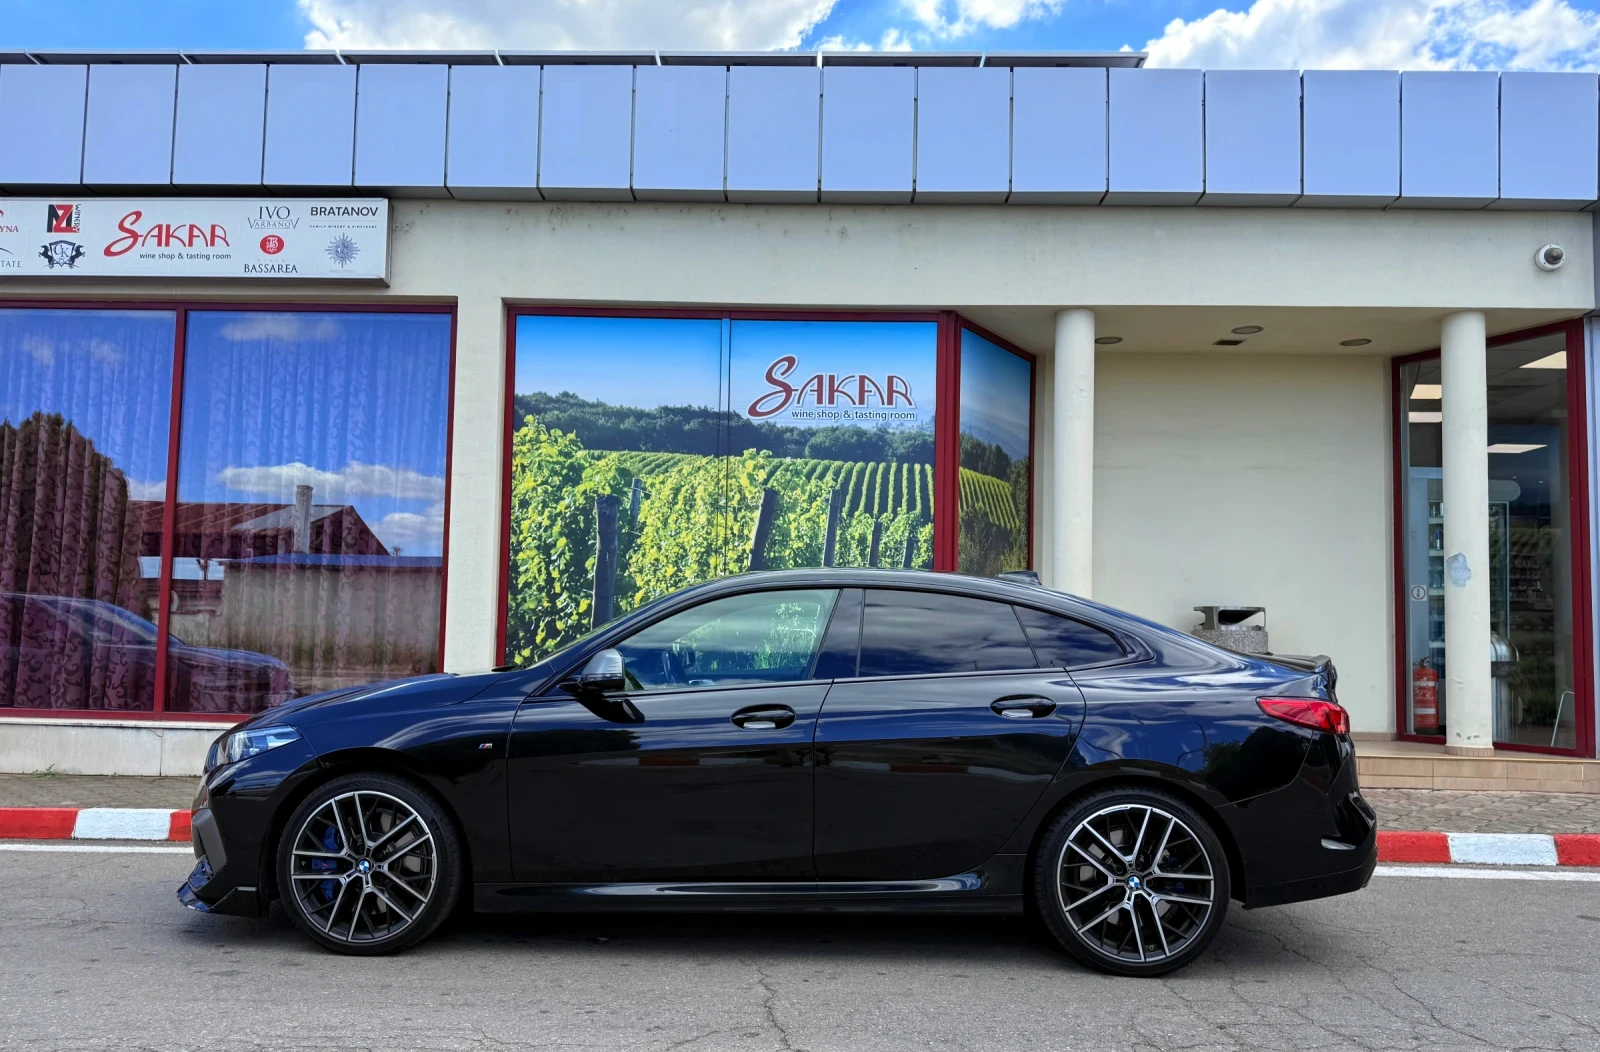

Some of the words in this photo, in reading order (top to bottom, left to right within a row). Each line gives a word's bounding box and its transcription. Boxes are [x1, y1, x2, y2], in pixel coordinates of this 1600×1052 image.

[73, 203, 82, 232] WINERY
[259, 206, 291, 220] IVO
[310, 206, 379, 217] BRATANOV
[247, 216, 300, 230] VARBANOV
[103, 210, 231, 257] SAKAR
[158, 252, 176, 261] shop
[177, 252, 184, 260] &
[186, 252, 211, 261] tasting
[244, 263, 299, 274] BASSAREA
[748, 355, 913, 417] SAKAR
[791, 410, 814, 419] wine
[816, 409, 840, 421] shop
[843, 410, 852, 419] &
[855, 409, 887, 421] tasting
[890, 411, 915, 420] room
